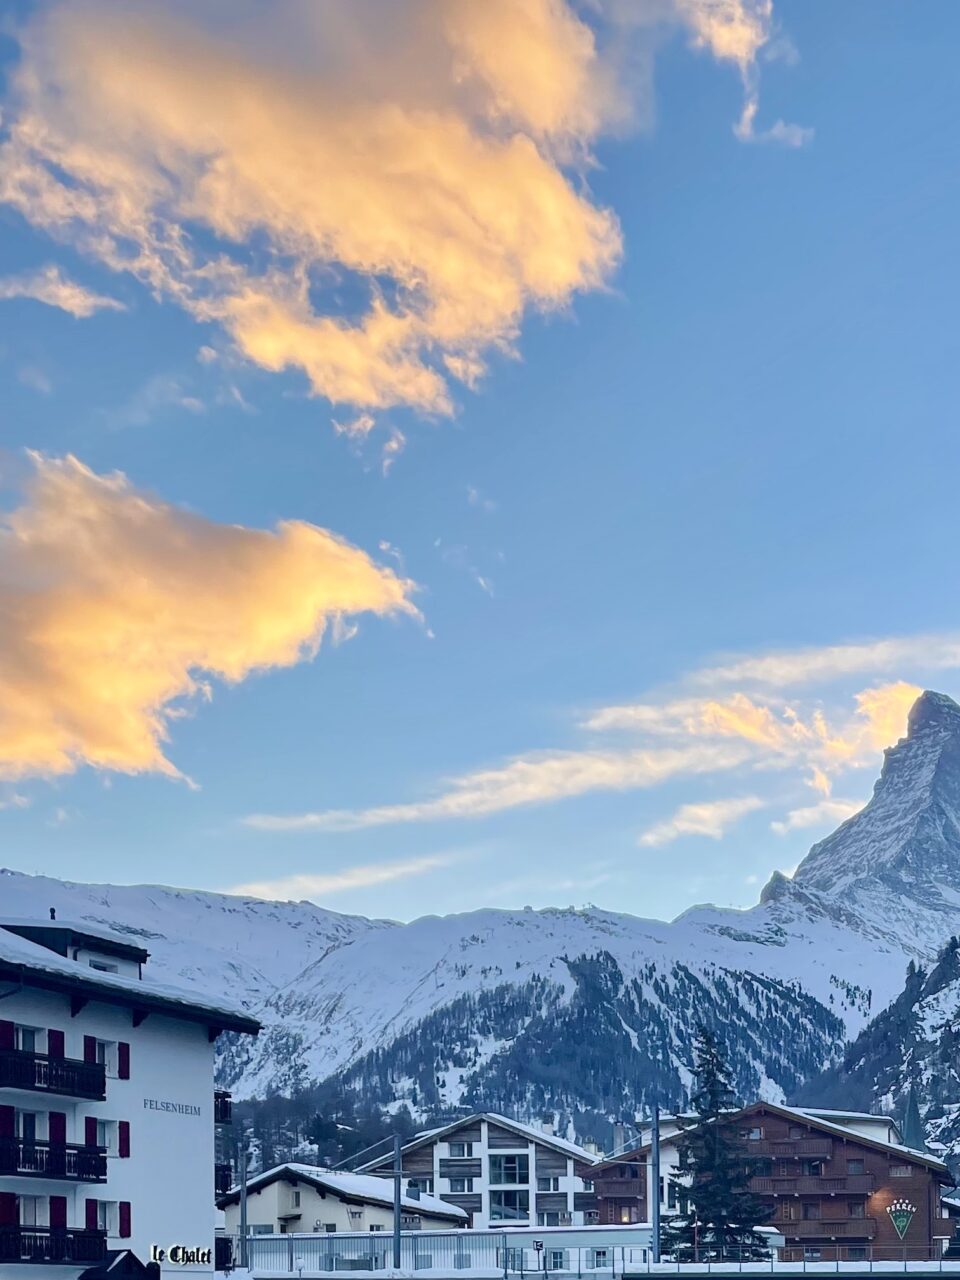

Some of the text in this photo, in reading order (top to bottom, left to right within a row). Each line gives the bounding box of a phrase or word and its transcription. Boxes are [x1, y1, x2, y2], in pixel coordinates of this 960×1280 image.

[143, 1098, 201, 1116] FELSENHEIM
[886, 1203, 917, 1214] PERREN
[169, 1245, 212, 1266] Chalet
